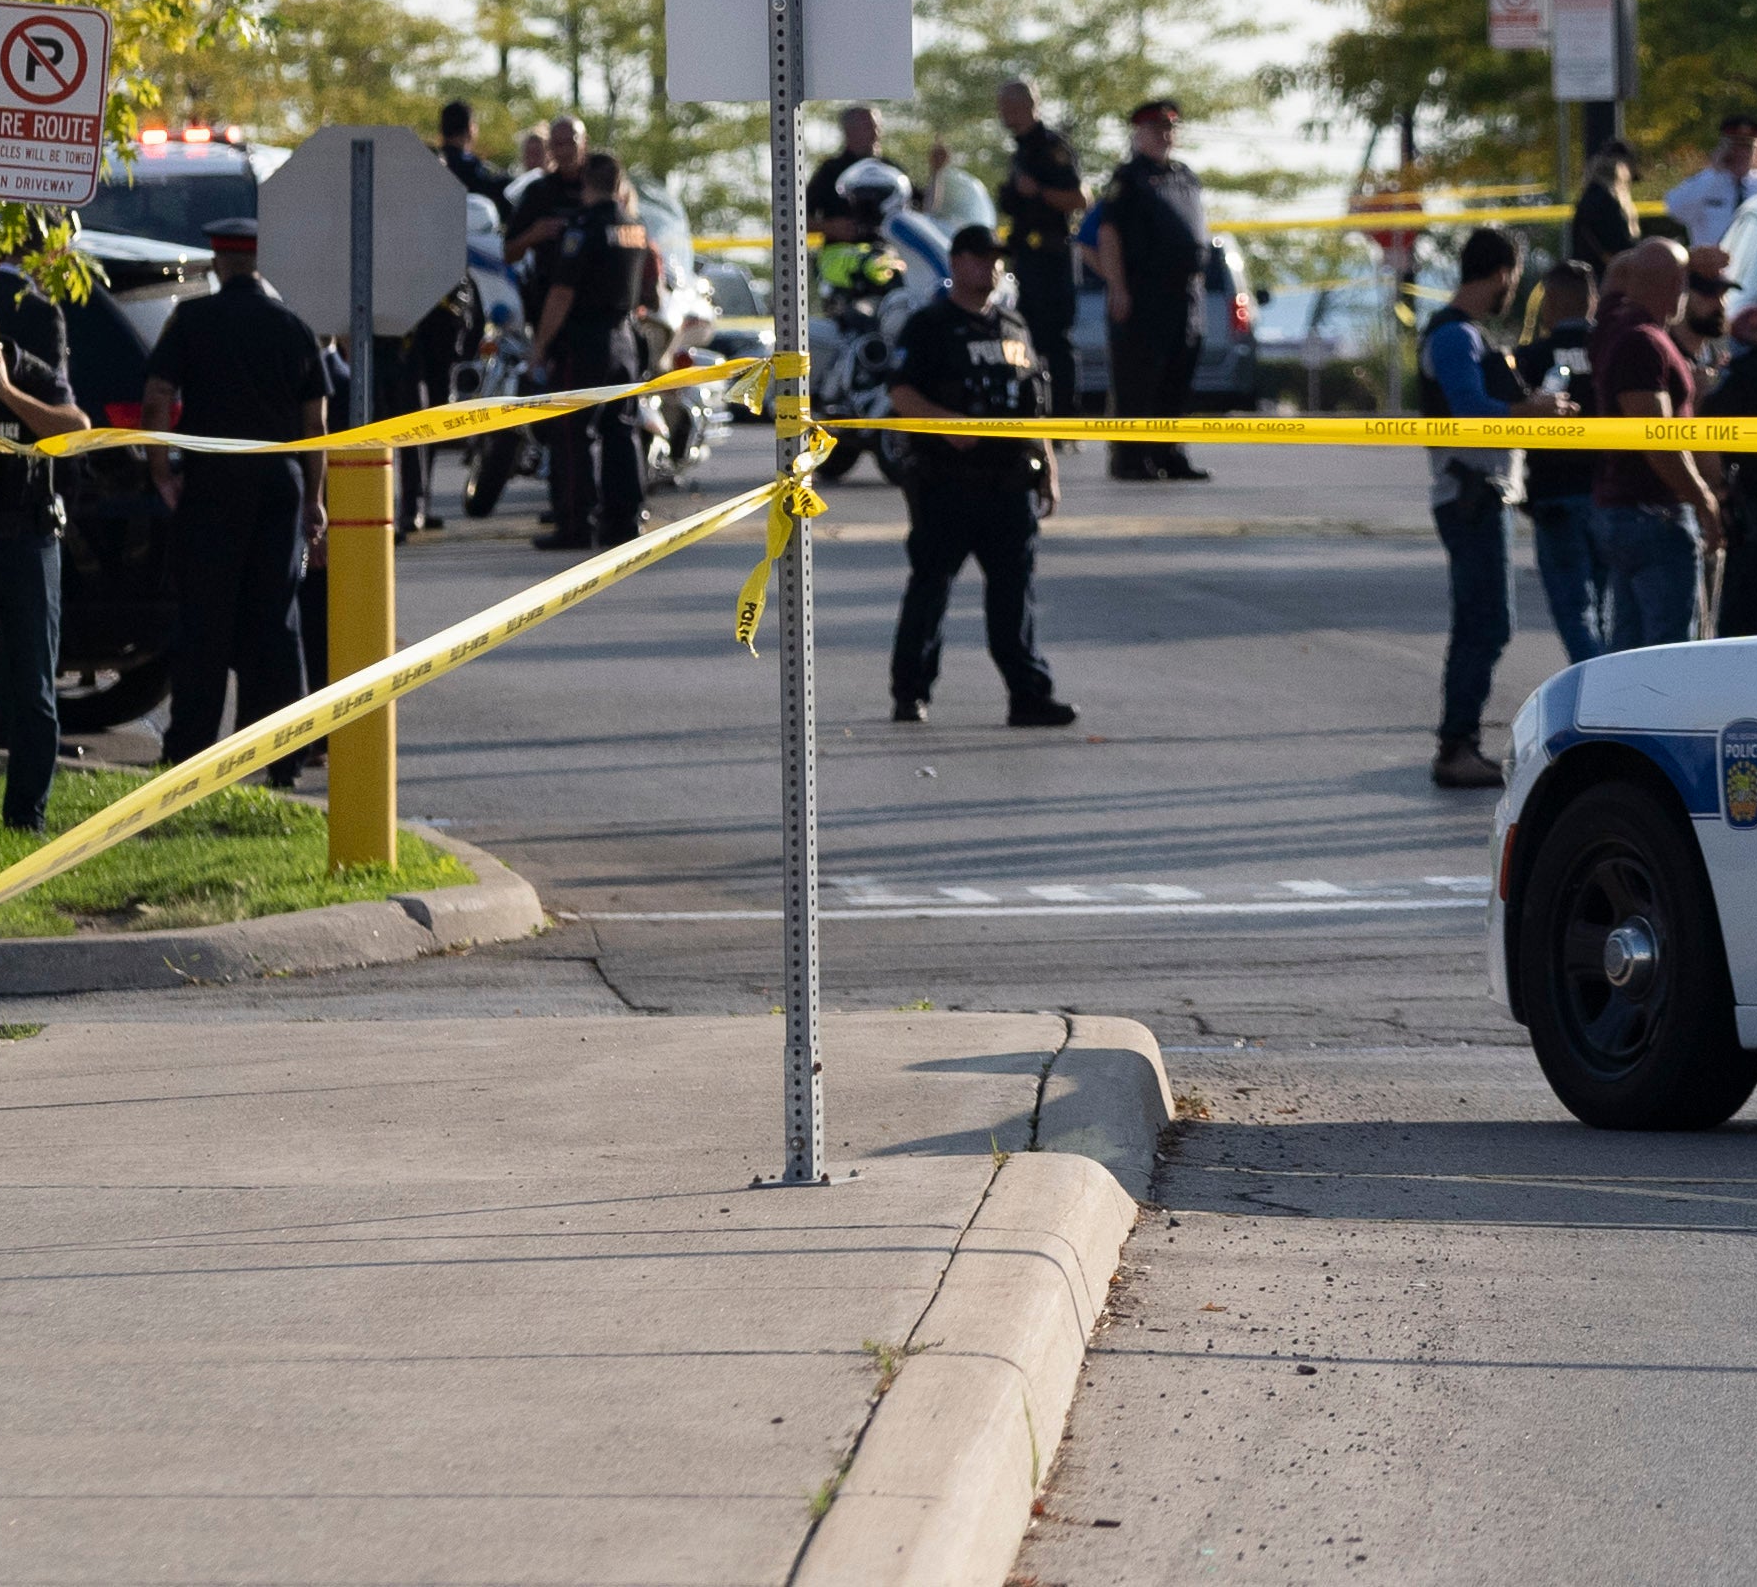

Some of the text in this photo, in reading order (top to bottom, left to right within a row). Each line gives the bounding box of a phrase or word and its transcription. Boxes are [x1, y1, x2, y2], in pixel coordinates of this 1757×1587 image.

[33, 115, 94, 143] ROUTE
[25, 147, 44, 162] WILL
[49, 150, 61, 163] BE
[65, 151, 92, 166] TOWED
[15, 176, 74, 193] DRIVEWAY
